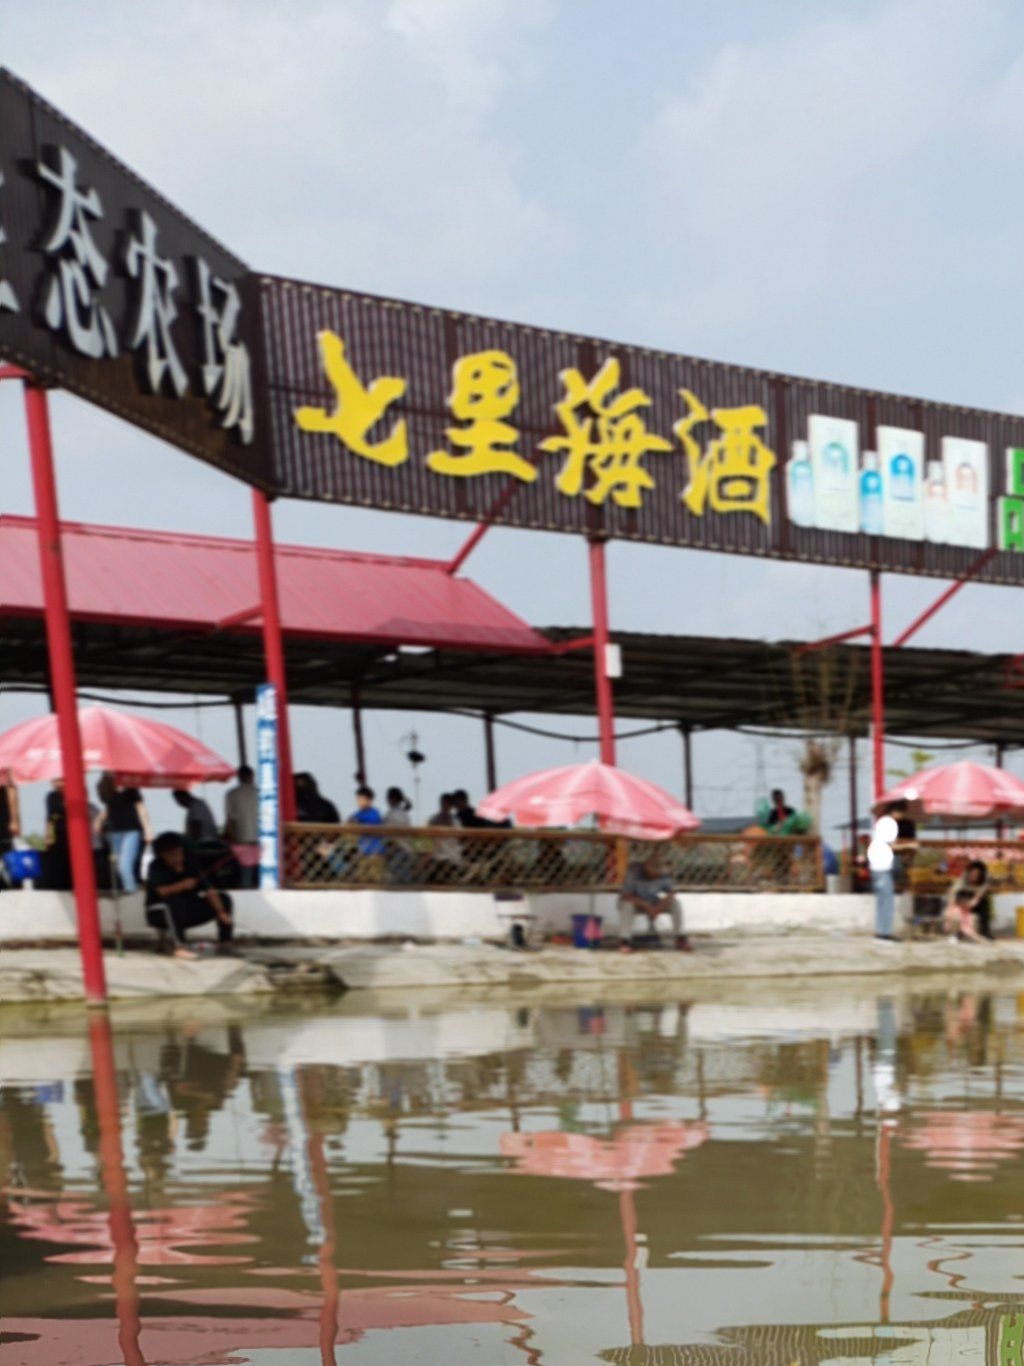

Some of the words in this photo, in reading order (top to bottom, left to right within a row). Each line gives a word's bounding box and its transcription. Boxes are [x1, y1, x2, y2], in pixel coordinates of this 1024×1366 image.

[0, 144, 255, 445] 态农场
[295, 329, 774, 524] 七里海酒
